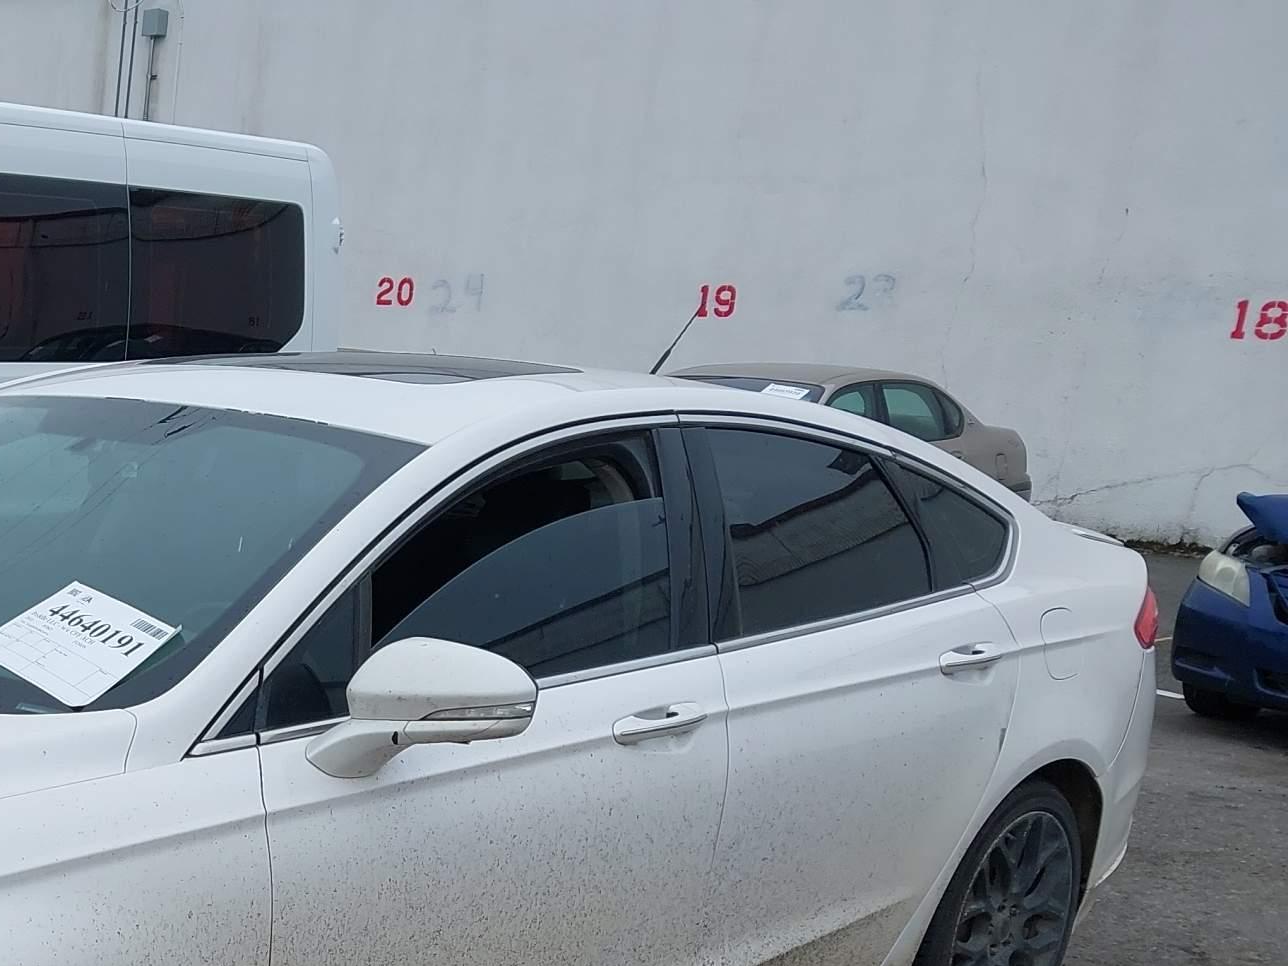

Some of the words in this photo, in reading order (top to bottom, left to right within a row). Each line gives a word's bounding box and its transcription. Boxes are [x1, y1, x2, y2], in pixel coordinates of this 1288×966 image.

[375, 276, 415, 306] 20
[429, 273, 485, 314] 24
[696, 284, 737, 318] 19
[1230, 299, 1288, 340] 18
[48, 603, 145, 658] 44640191
